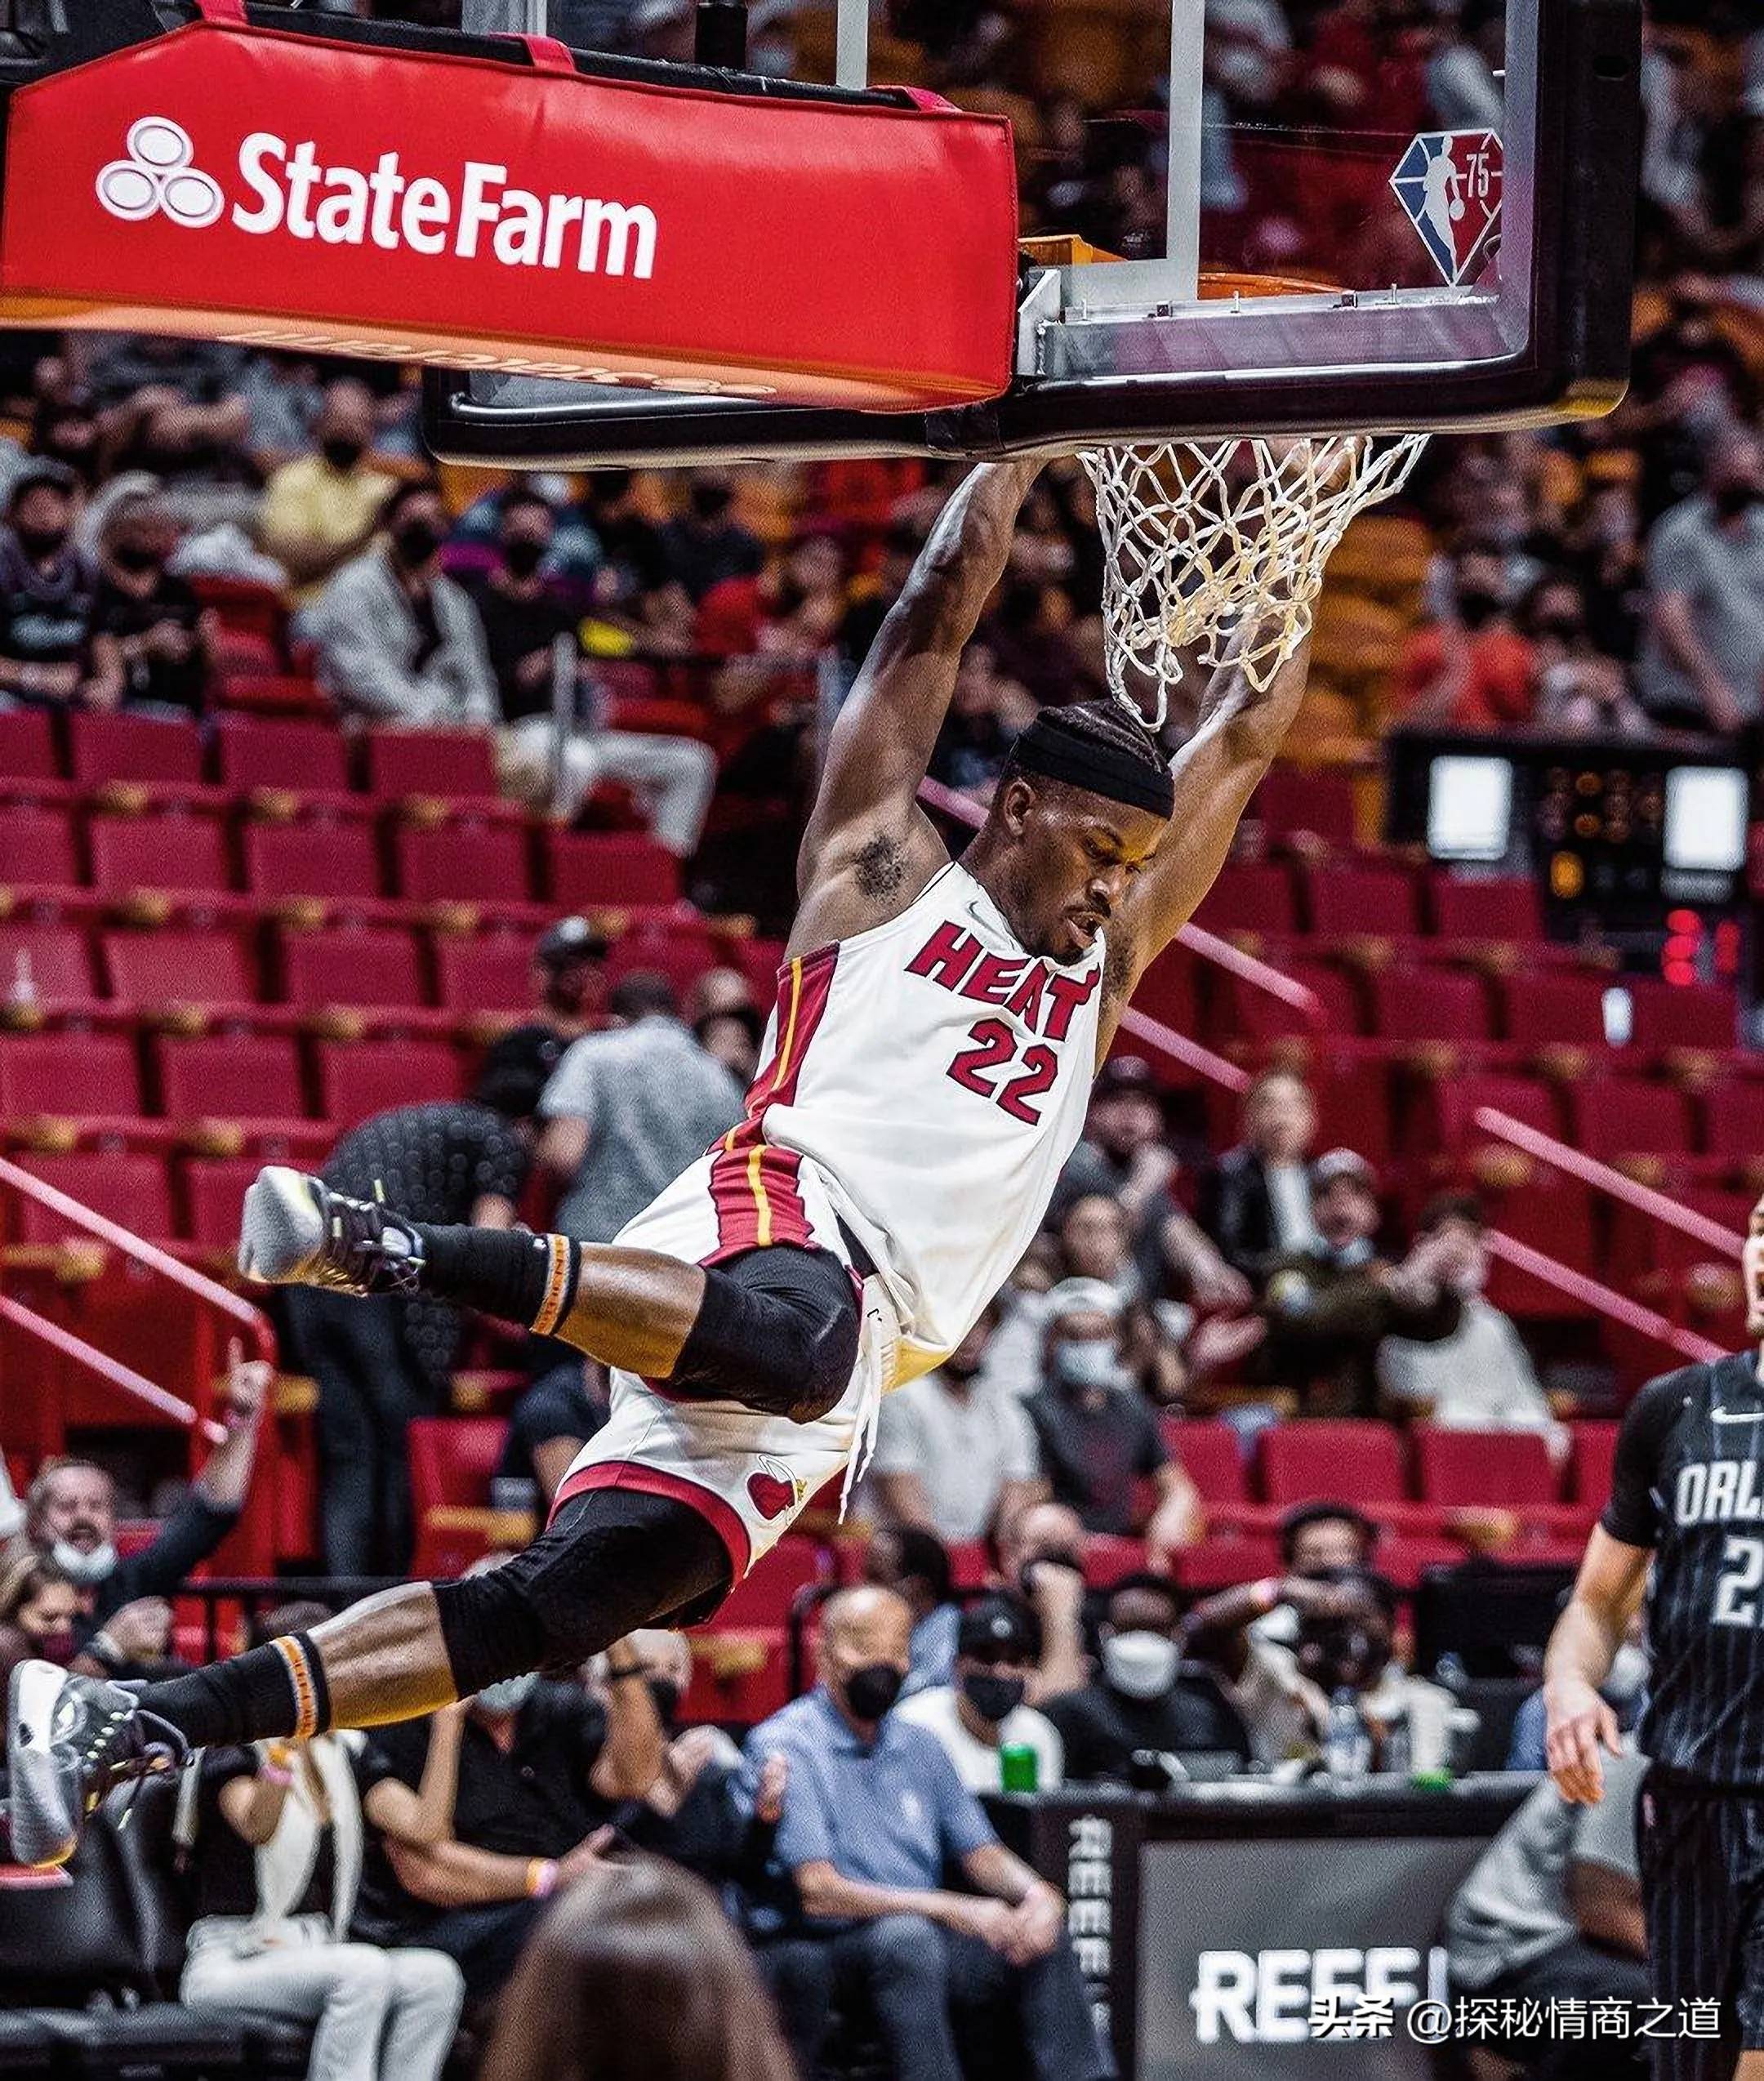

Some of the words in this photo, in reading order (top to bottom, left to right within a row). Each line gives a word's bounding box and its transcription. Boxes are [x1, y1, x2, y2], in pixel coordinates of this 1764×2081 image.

[1466, 153, 1490, 198] 75
[904, 920, 1102, 1042] HEAT
[946, 1017, 1058, 1126] 22
[1675, 1459, 1764, 1526] ORL
[1713, 1535, 1764, 1625] 2
